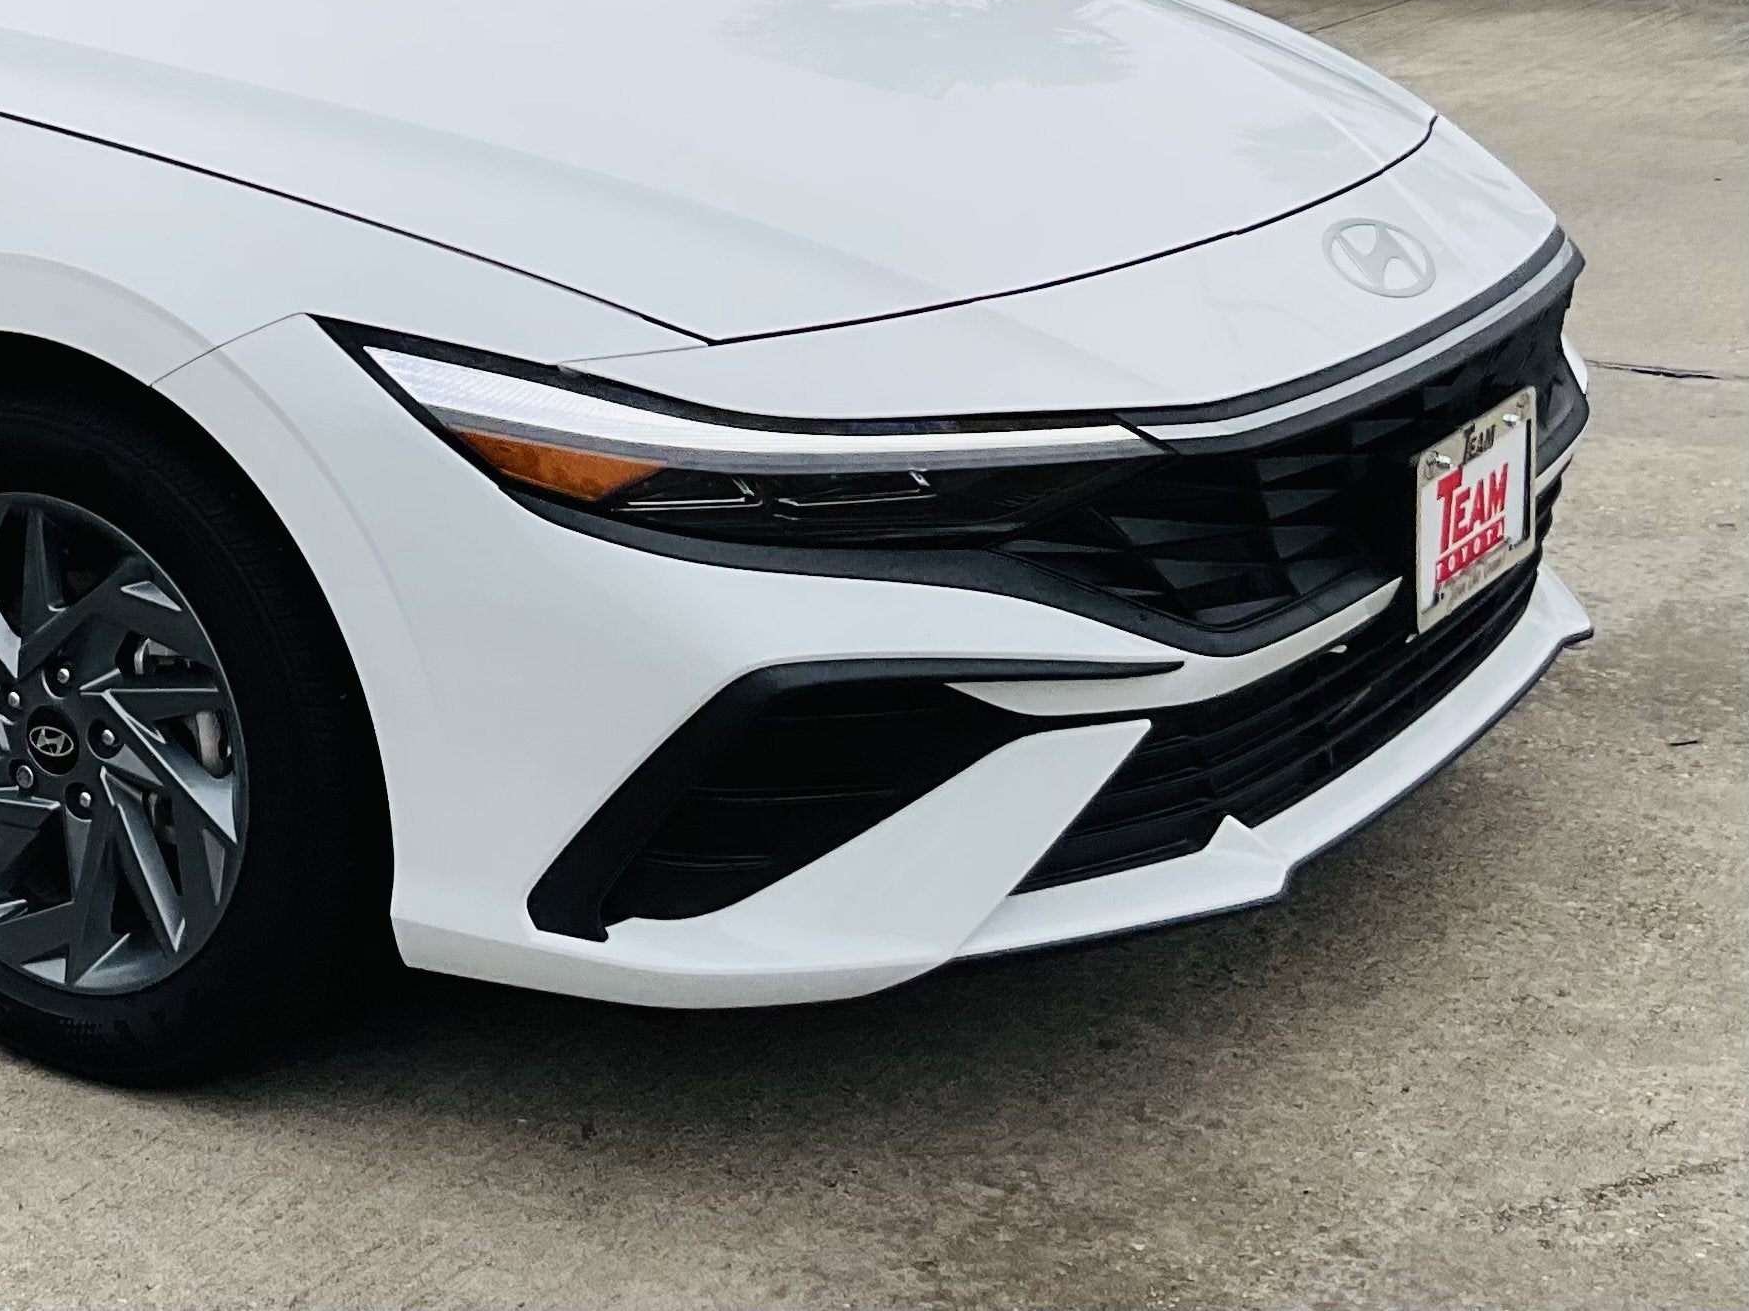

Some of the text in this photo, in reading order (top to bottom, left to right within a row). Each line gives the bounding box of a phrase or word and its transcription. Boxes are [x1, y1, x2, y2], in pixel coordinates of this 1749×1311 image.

[1461, 421, 1497, 466] TEAM
[1436, 462, 1510, 556] TEAM
[1436, 520, 1507, 583] TOYOTA
